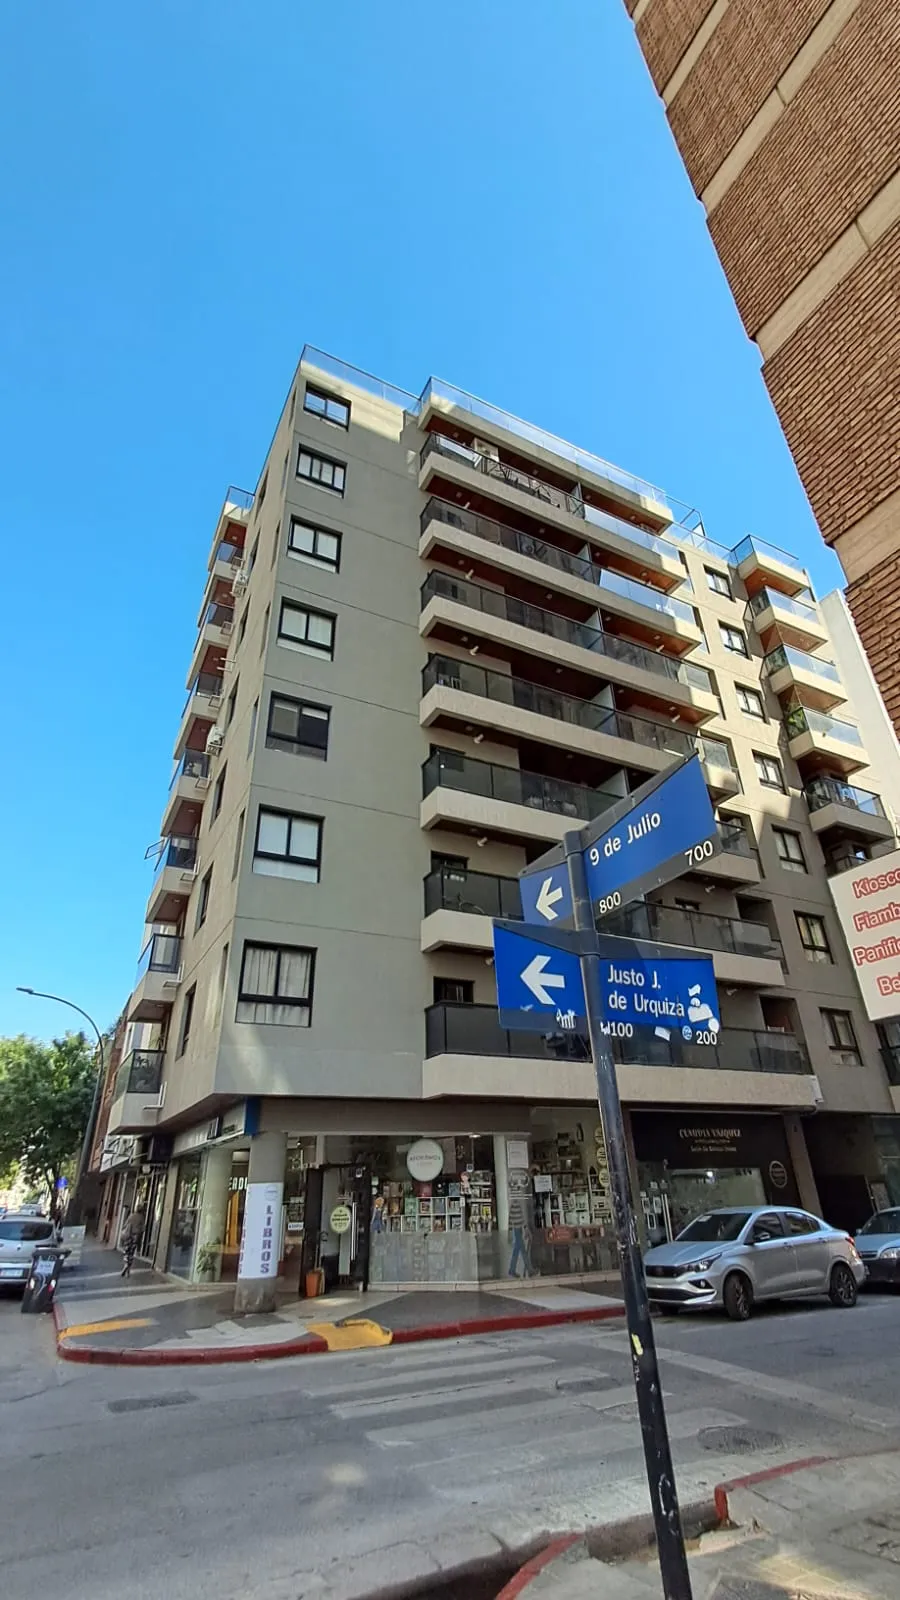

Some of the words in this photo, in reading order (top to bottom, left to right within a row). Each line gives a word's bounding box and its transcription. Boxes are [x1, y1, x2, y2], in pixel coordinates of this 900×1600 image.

[589, 847, 600, 866] 9
[603, 837, 622, 857] de
[627, 812, 661, 844] Julio
[684, 840, 713, 866] 700
[599, 891, 621, 914] 800
[607, 964, 645, 987] Justo
[651, 970, 662, 989] J.
[877, 973, 900, 996] Be
[608, 990, 628, 1010] de
[634, 992, 685, 1018] Urquiza
[695, 1030, 718, 1046] 200
[260, 1204, 274, 1274] LIBROS
